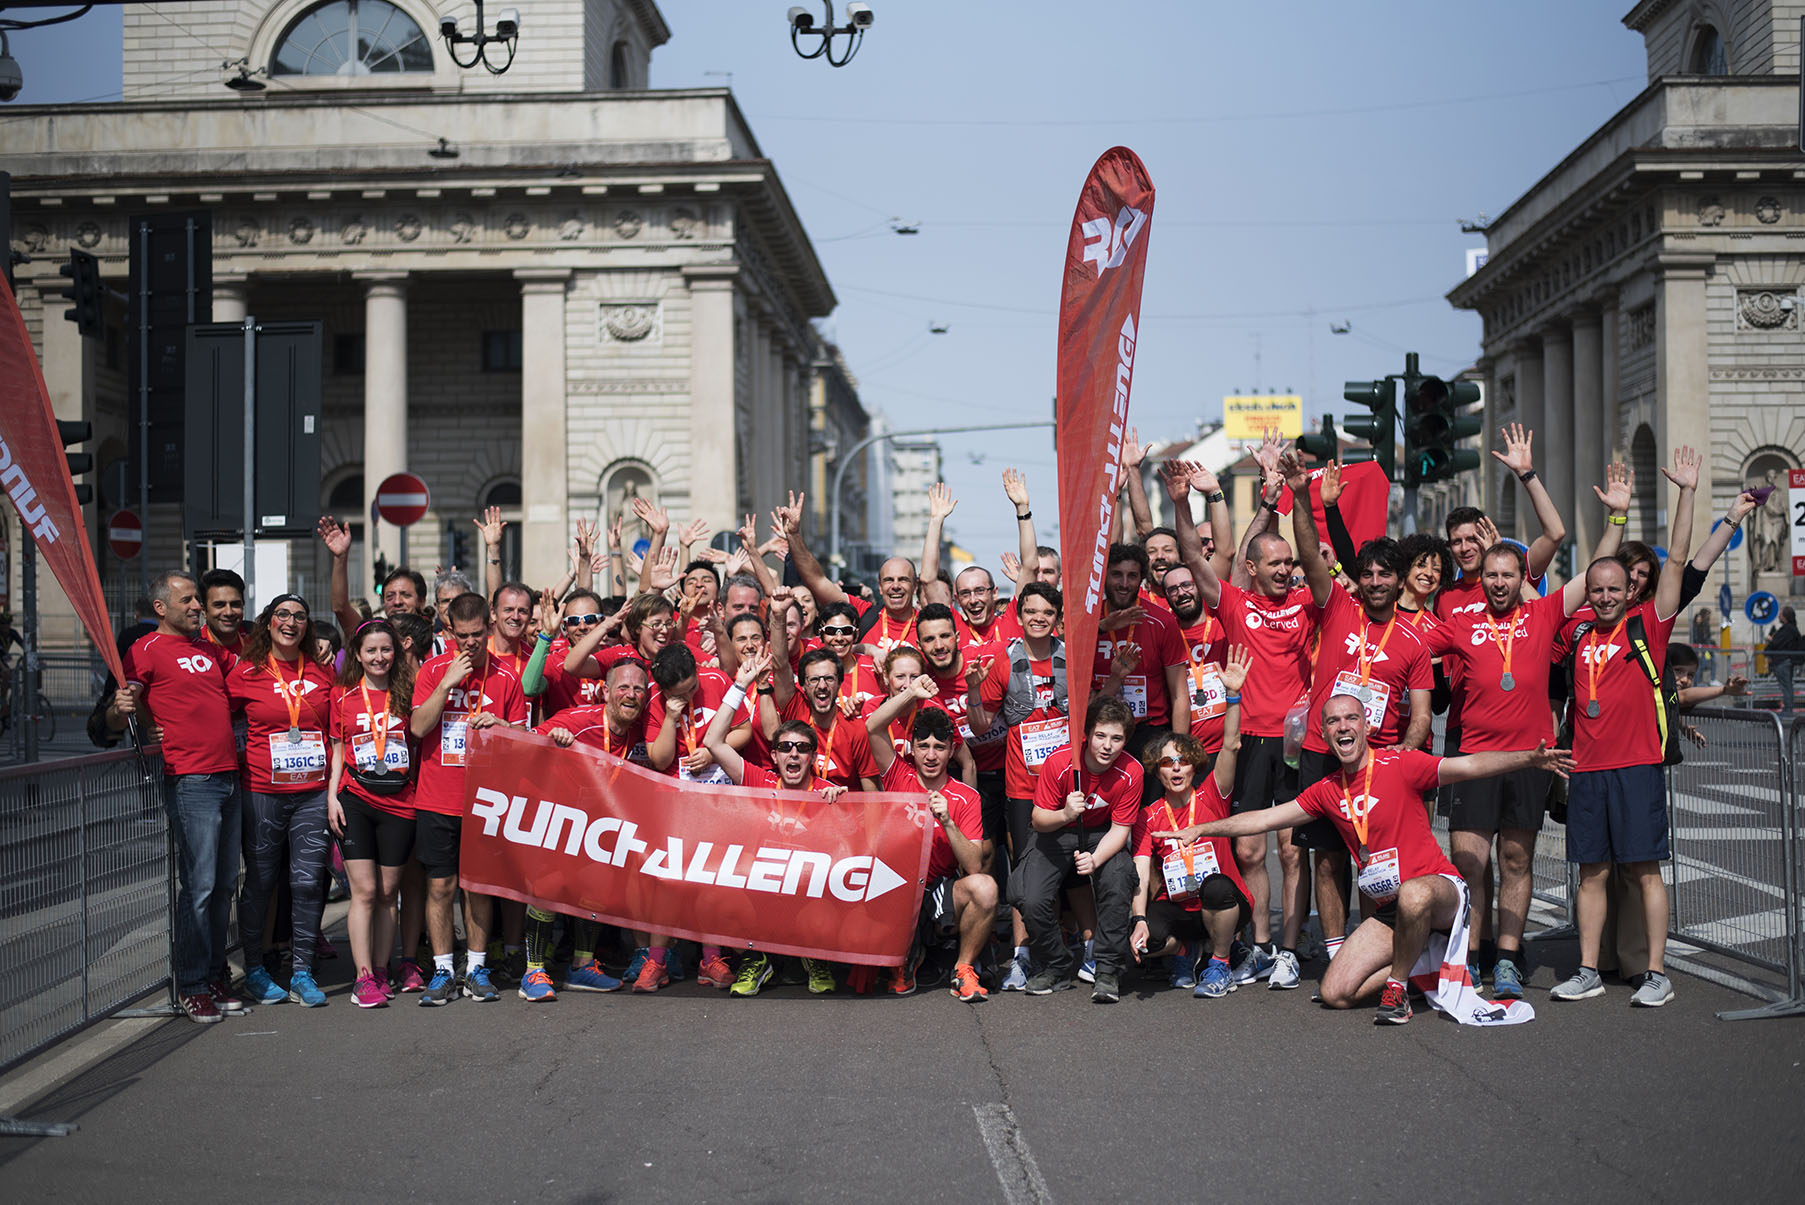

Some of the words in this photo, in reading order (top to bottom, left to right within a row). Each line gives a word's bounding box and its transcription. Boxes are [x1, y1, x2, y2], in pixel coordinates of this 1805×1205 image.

[1263, 617, 1299, 629] Cerved
[1488, 626, 1528, 642] Cered
[285, 756, 314, 768] 1361C
[367, 752, 399, 766] 134B
